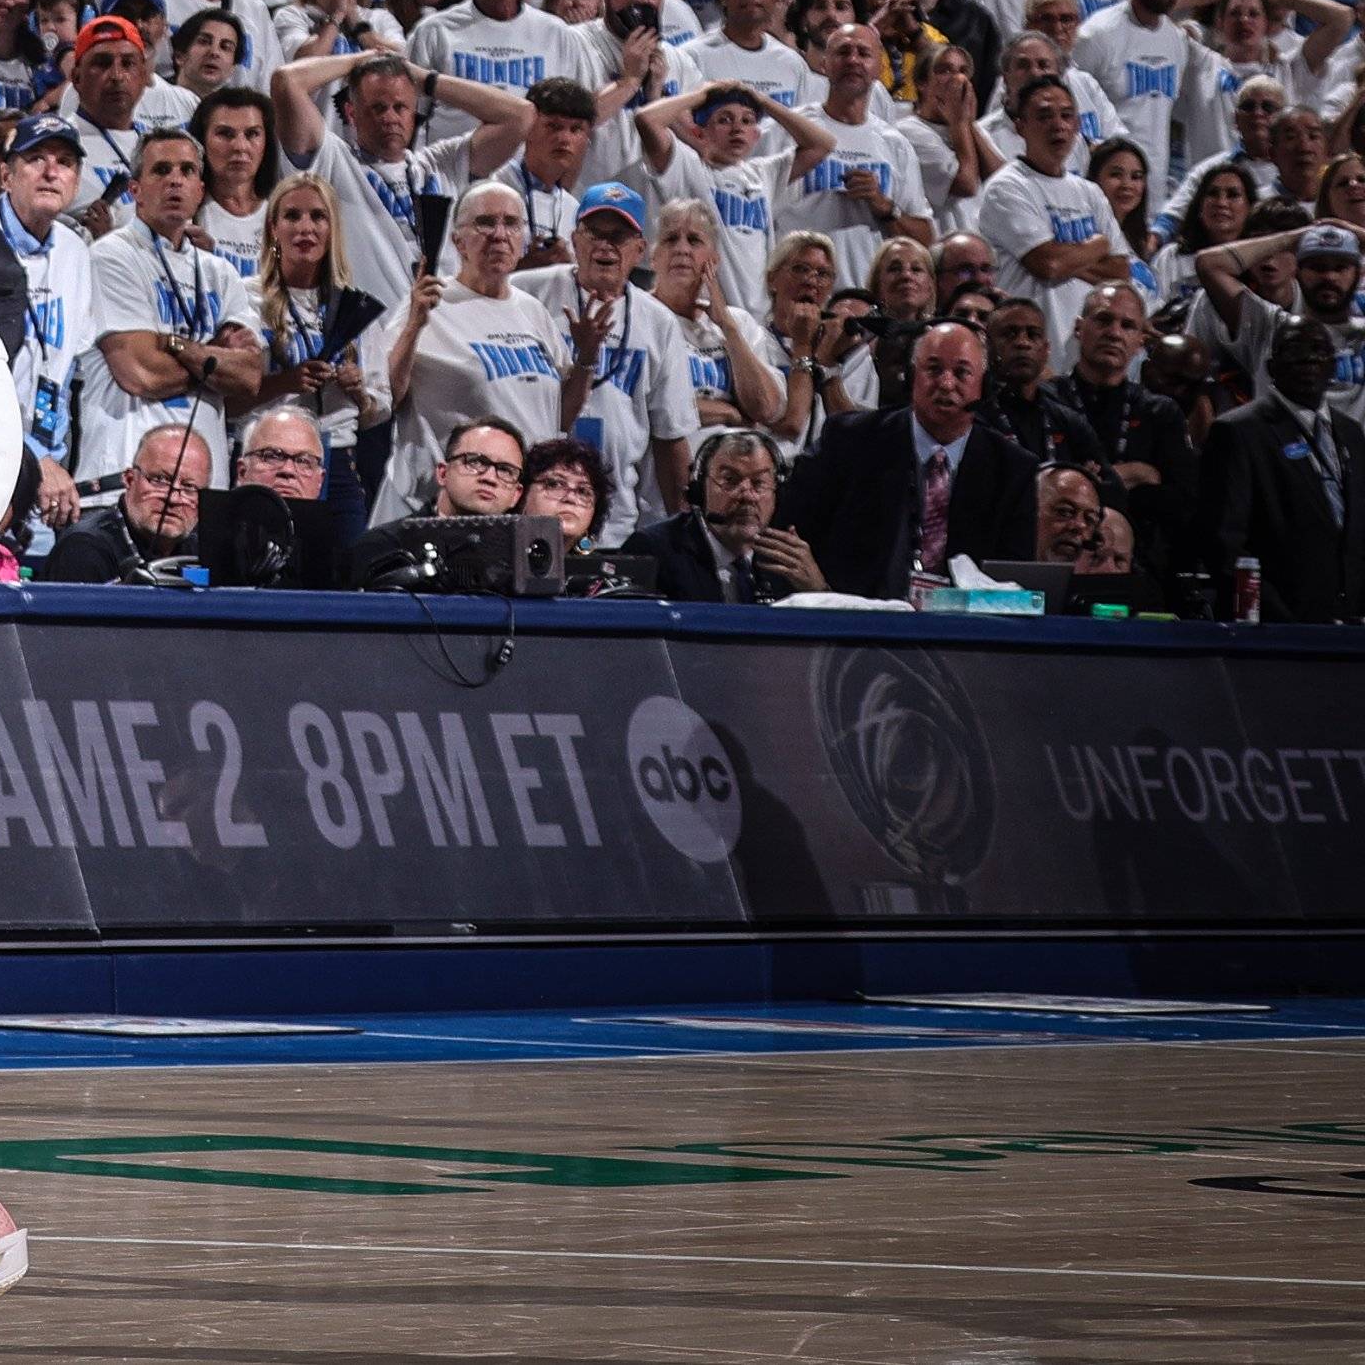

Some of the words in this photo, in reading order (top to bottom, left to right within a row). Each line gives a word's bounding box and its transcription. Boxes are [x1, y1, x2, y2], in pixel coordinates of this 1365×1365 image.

[190, 701, 268, 847] 2
[288, 701, 493, 850] 8PM
[491, 713, 603, 848] ET
[638, 745, 732, 803] abc
[1043, 747, 1365, 824] UNFORGET
